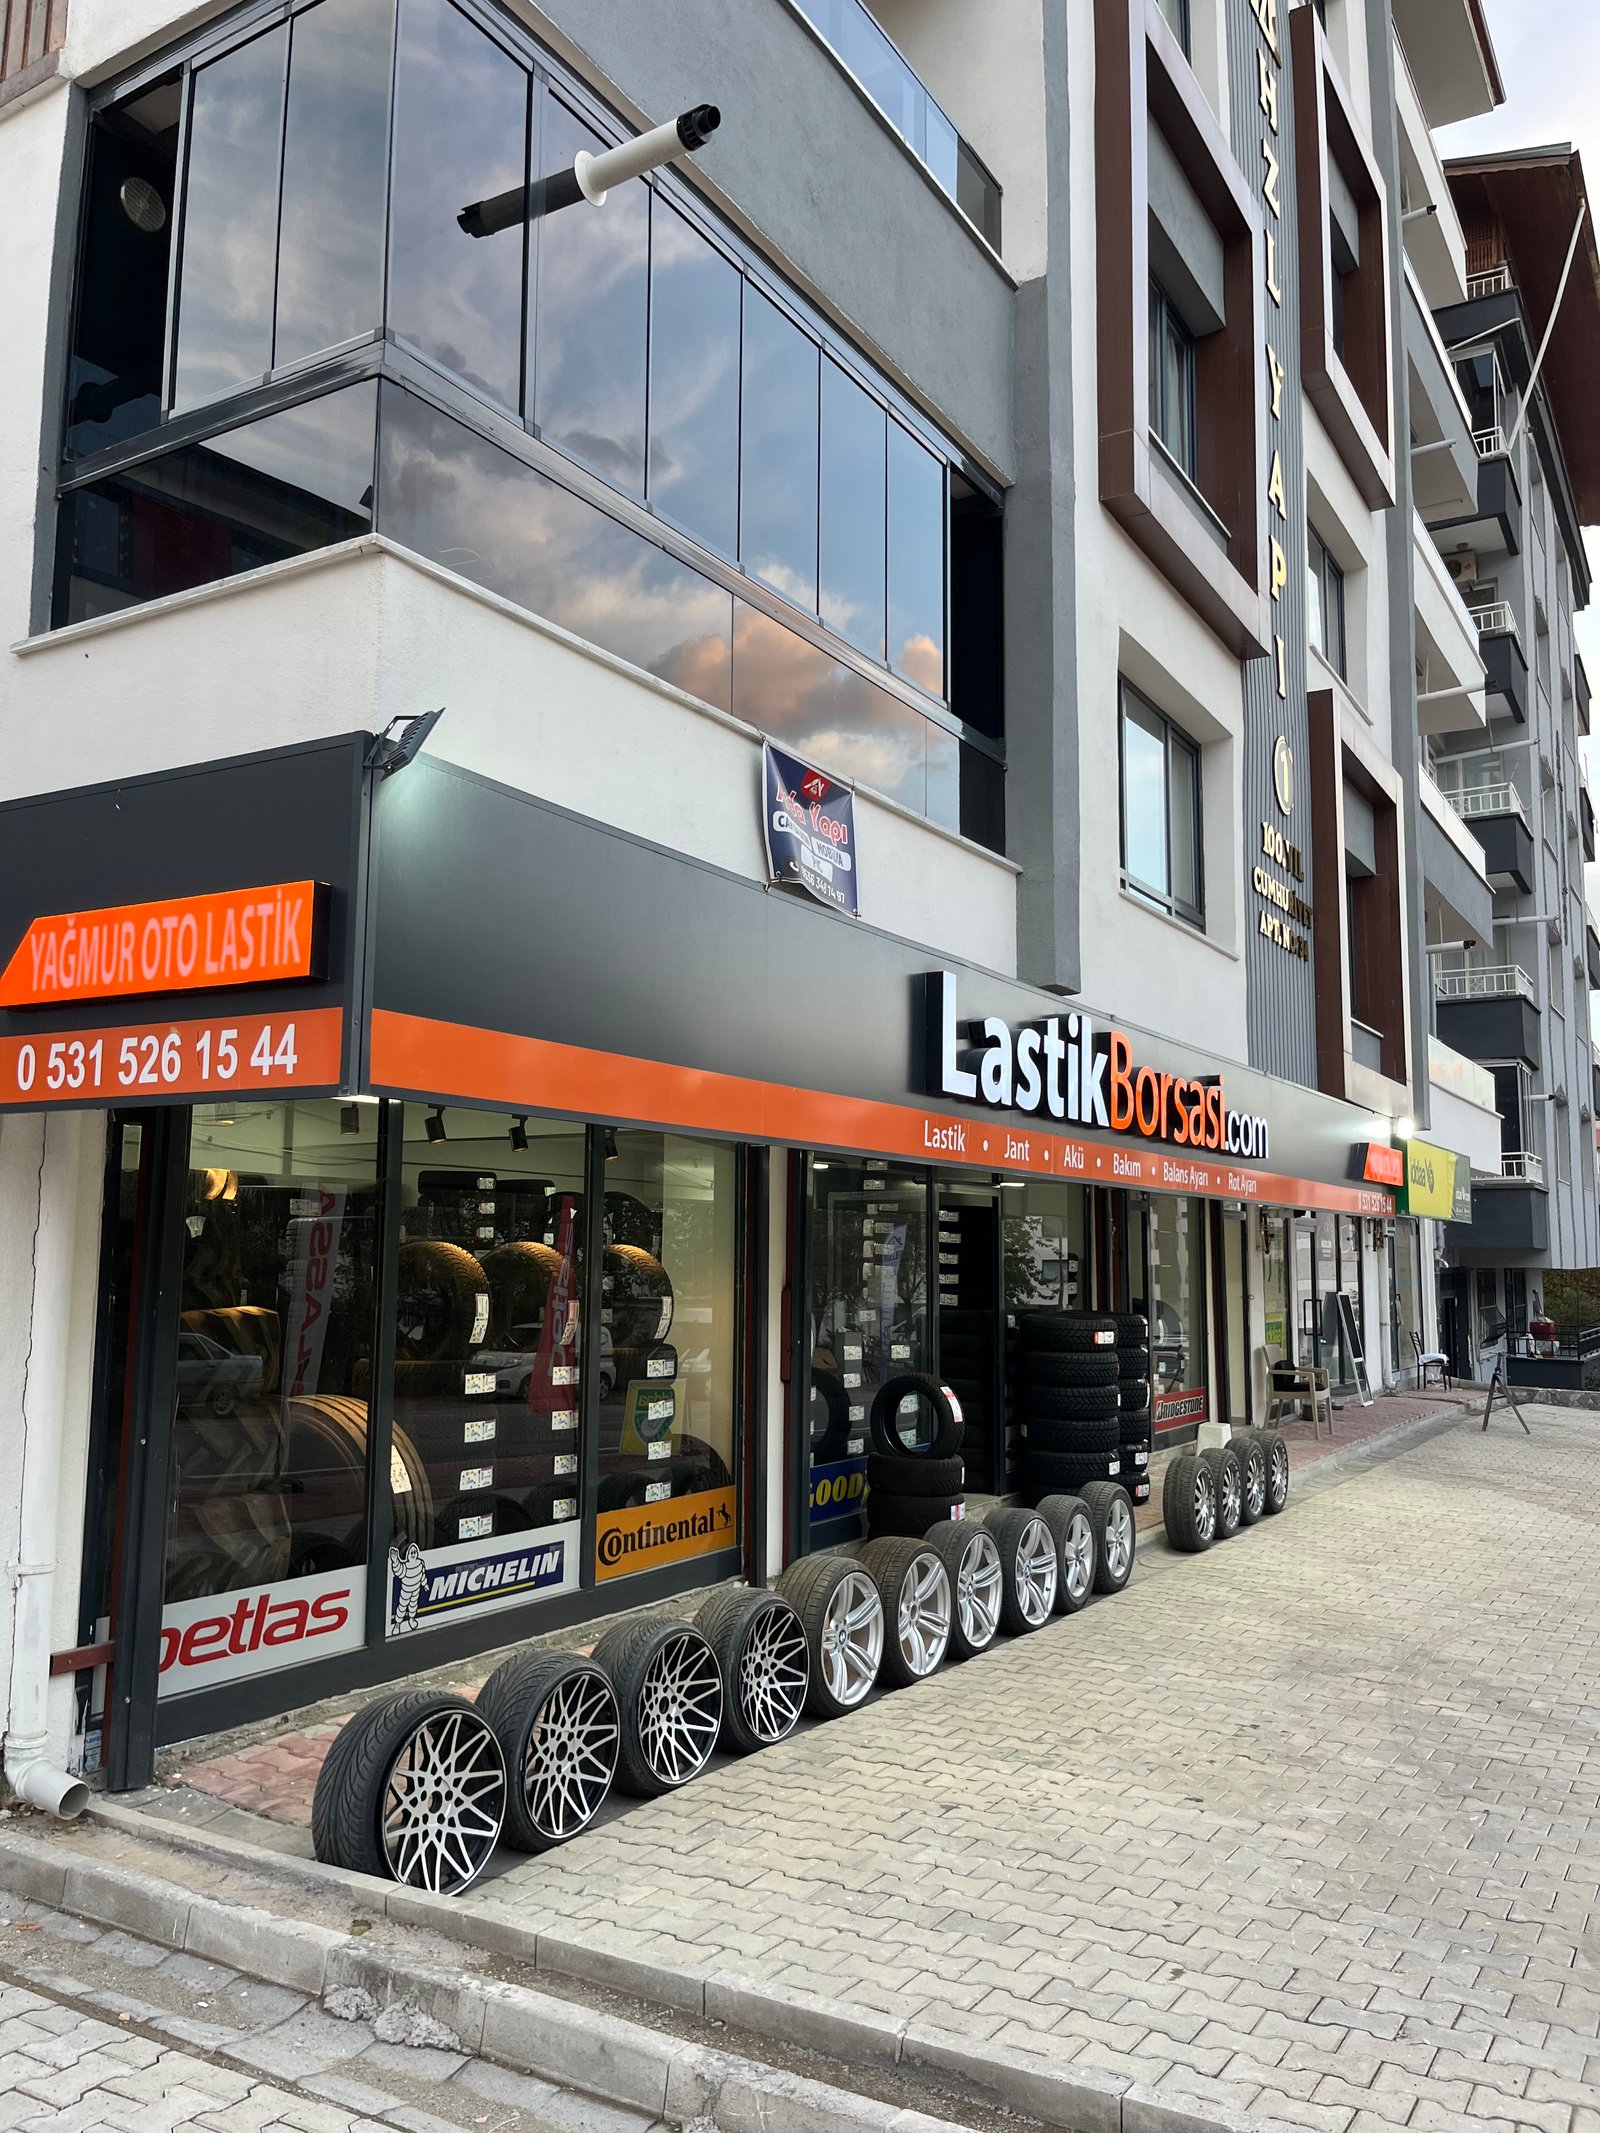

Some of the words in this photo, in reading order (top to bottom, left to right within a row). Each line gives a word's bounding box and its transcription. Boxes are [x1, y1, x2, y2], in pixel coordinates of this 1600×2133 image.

[30, 916, 136, 991] YAĞMUR
[141, 913, 198, 979] OTO
[204, 888, 302, 975] LASTİK
[17, 1044, 36, 1091] 0
[46, 1038, 104, 1090] 531
[117, 1032, 183, 1086] 526
[196, 1028, 239, 1081] 15
[250, 1023, 298, 1076] 44
[923, 1120, 966, 1152] Lastik
[1003, 1134, 1030, 1163] Jant
[1063, 1145, 1085, 1170] Akü
[1113, 1153, 1142, 1178] Bakım
[1163, 1162, 1189, 1185] Balans
[1228, 1172, 1241, 1189] Rot
[1155, 1395, 1204, 1422] BRIDGESTONE
[597, 1506, 717, 1566] Continental
[428, 1547, 561, 1602] MICHELIN
